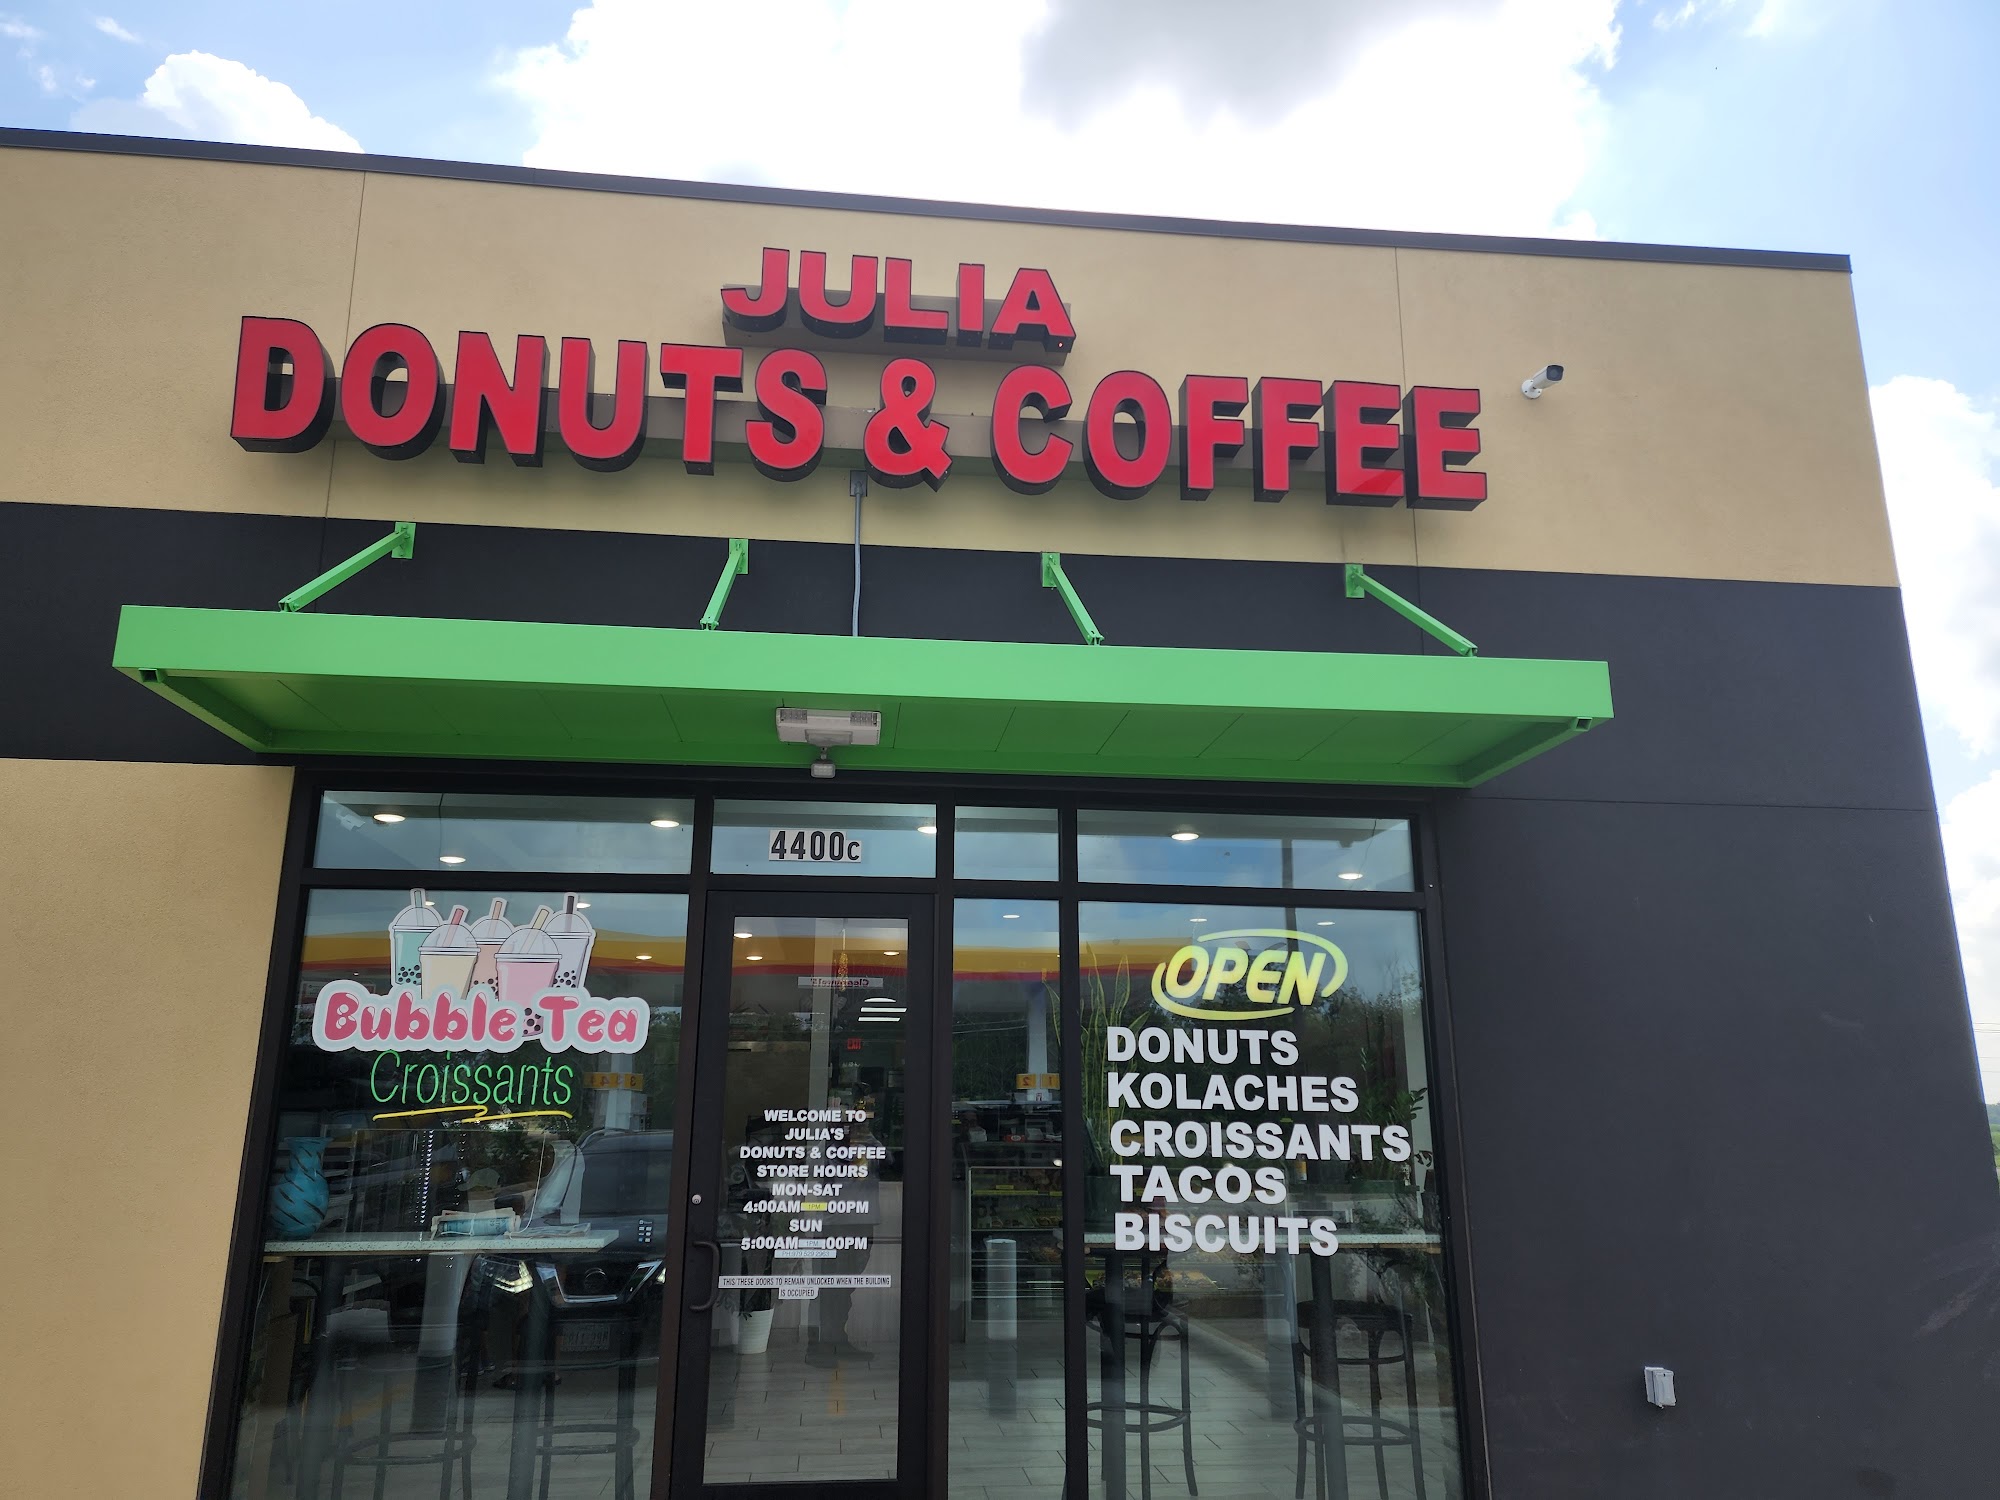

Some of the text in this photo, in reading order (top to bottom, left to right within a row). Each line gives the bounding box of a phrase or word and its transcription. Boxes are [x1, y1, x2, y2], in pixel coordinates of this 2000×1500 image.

[721, 247, 1076, 344] JULIA
[230, 316, 1488, 506] DONUTS & COFFEE
[1165, 945, 1326, 1006] OPEN
[325, 991, 638, 1043] Bubble Tea
[1107, 1026, 1299, 1066] DONUTS
[370, 1050, 573, 1105] Croissants
[1107, 1072, 1359, 1112] KOLACHES
[764, 1109, 867, 1122] WELCOME TO
[784, 1128, 845, 1141] JULIA'S
[1110, 1119, 1411, 1162] CROISSANTS
[740, 1146, 886, 1159] DONUTS & COFFEE
[757, 1165, 868, 1178] STORE HOURS
[1109, 1164, 1287, 1204] TACOS
[771, 1183, 843, 1197] MON-SAT
[743, 1200, 801, 1214] 4:00AM
[789, 1219, 823, 1232] SUN
[1114, 1212, 1339, 1257] BISCUITS
[741, 1236, 799, 1250] 5:00AM
[755, 1278, 774, 1286] DOORS
[776, 1278, 783, 1286] TO
[865, 1277, 890, 1285] BUILDING
[780, 1289, 815, 1297] IS OCCUPIED
